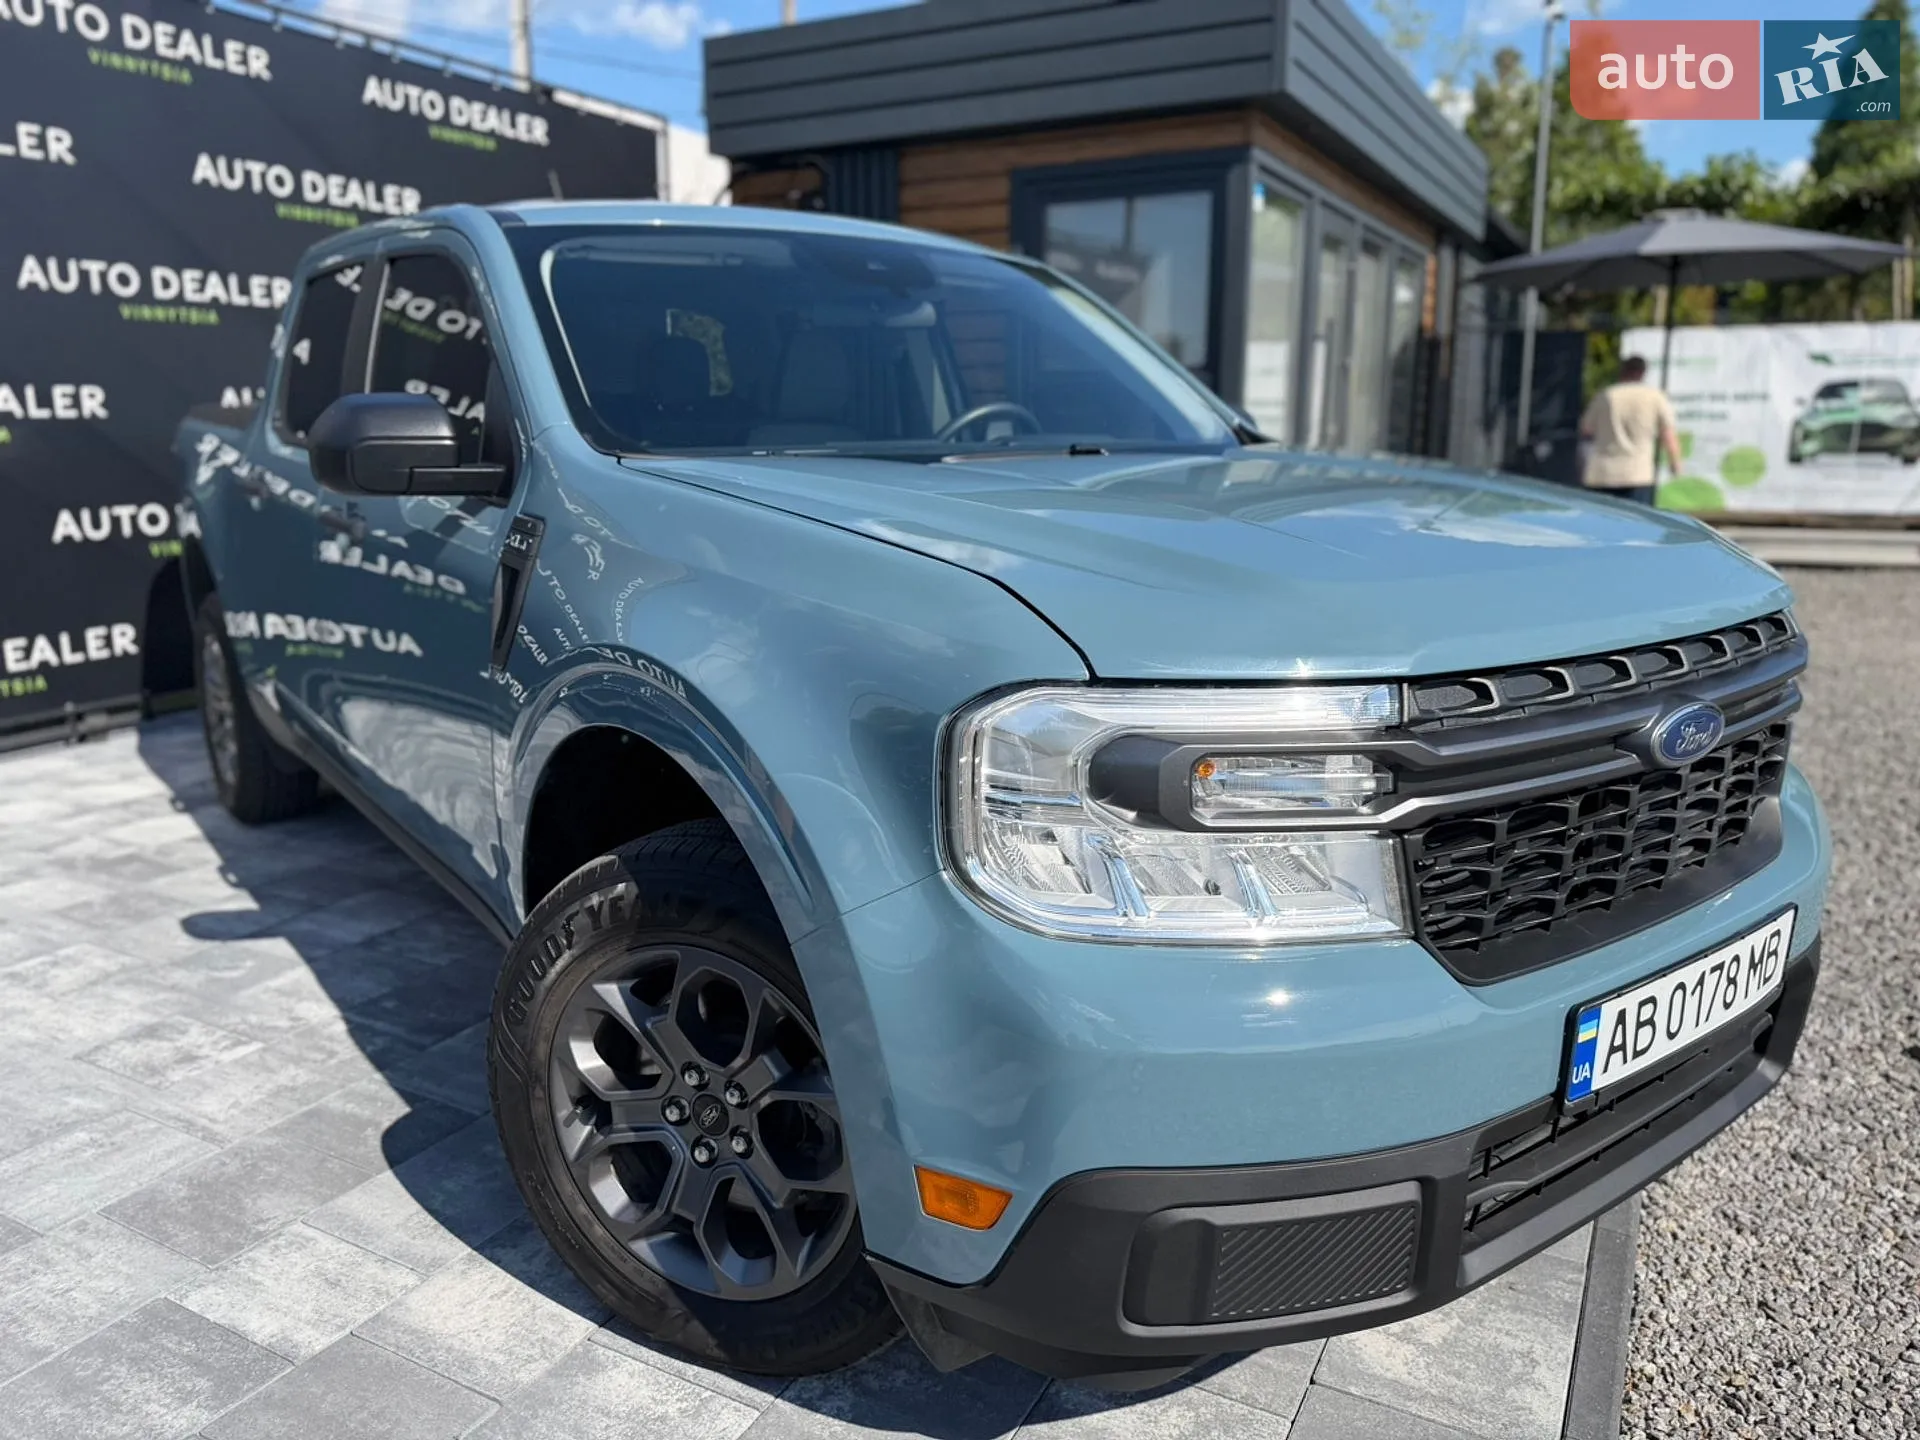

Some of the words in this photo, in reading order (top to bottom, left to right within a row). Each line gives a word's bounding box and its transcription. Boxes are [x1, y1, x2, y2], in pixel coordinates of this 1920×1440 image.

[120, 12, 273, 82] DEALER
[362, 75, 446, 121] AUTO
[449, 95, 551, 147] DEALER
[192, 152, 294, 198] AUTO
[301, 169, 422, 216] DEALER
[17, 254, 142, 298] AUTO
[150, 265, 292, 309] DEALER
[52, 502, 170, 544] AUTO
[2, 622, 140, 674] EALER
[1602, 995, 1658, 1076] AB
[1665, 954, 1741, 1041] 0178
[1744, 928, 1782, 1000] MB
[1571, 1065, 1592, 1084] UA
